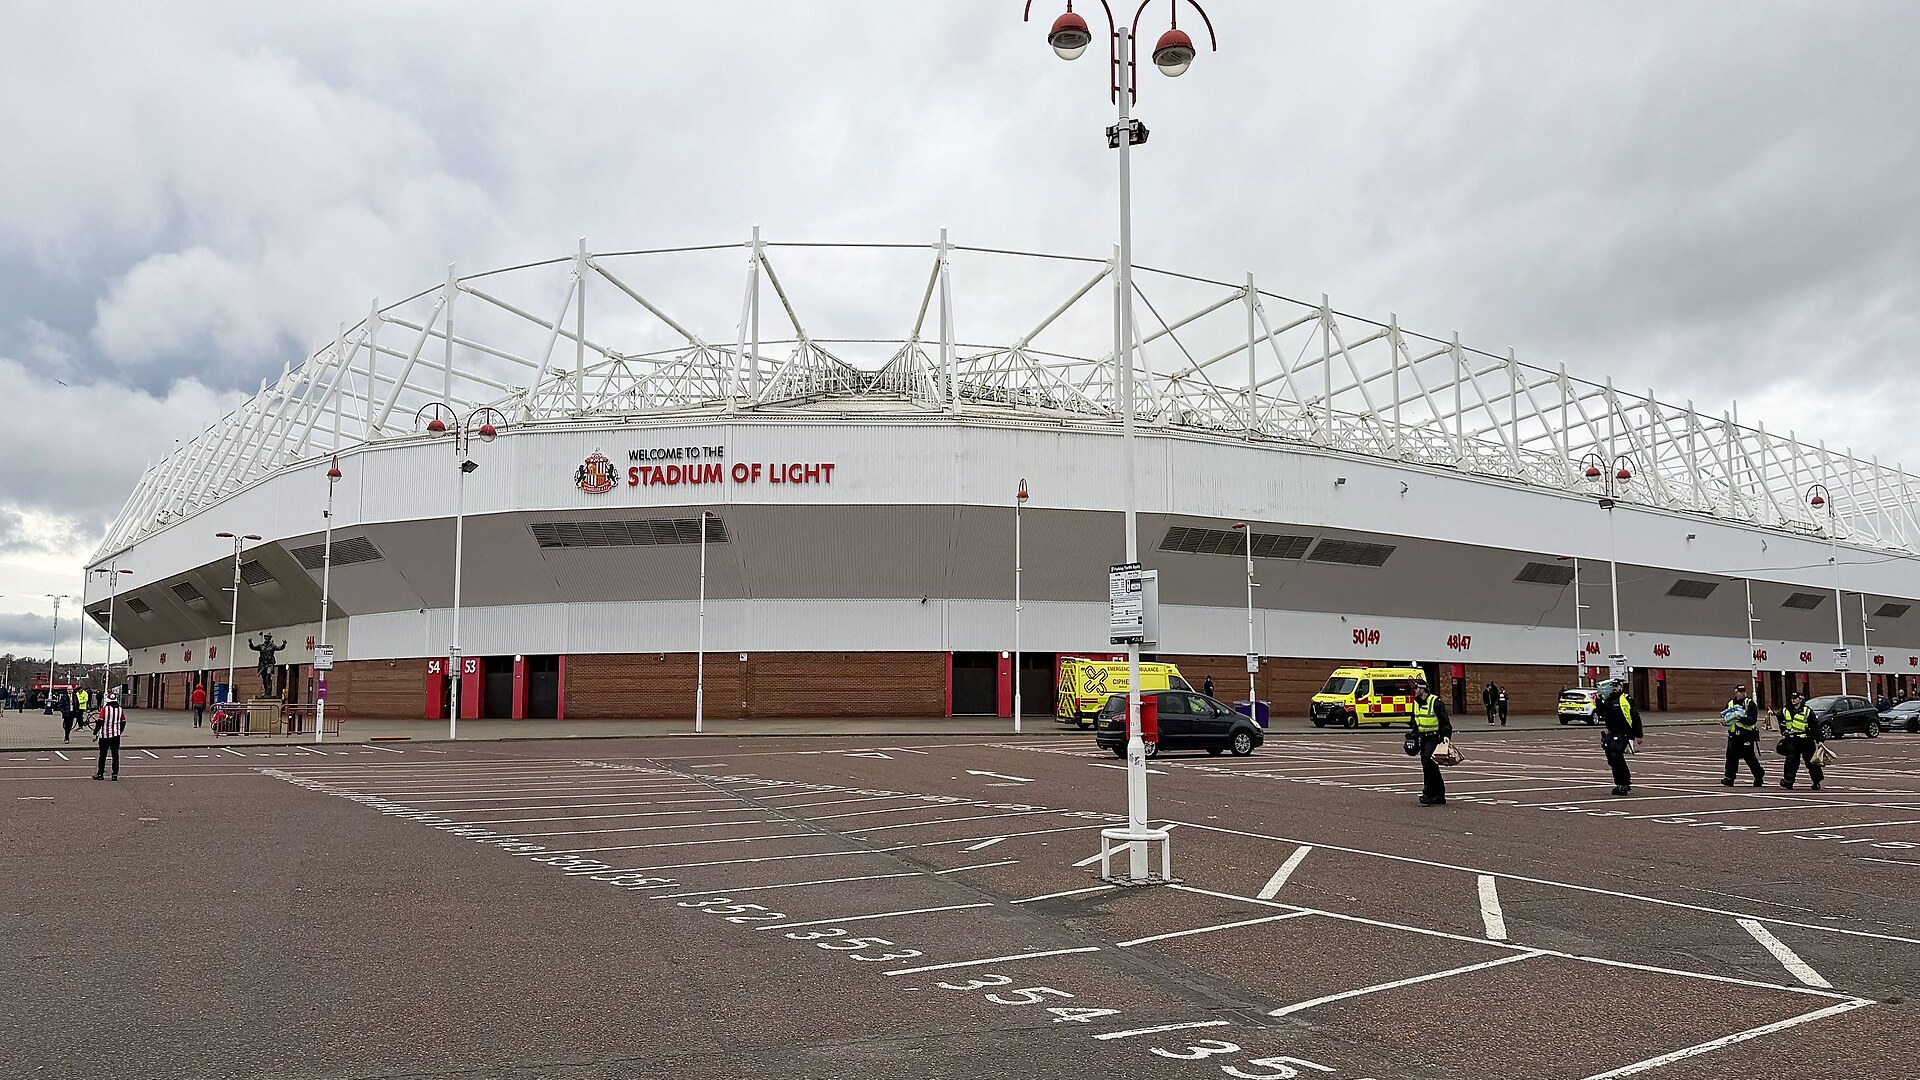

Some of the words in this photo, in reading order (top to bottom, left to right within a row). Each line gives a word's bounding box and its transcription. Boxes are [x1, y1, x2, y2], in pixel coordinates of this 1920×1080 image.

[628, 447, 683, 460] WELCOME
[684, 446, 700, 459] TO
[702, 446, 724, 458] THE
[628, 463, 723, 487] STADIUM
[731, 463, 761, 484] OF
[769, 463, 835, 484] LIGHT
[427, 660, 440, 674] 54
[464, 659, 476, 673] 53
[531, 855, 611, 871] 350
[589, 873, 680, 891] 351
[677, 898, 787, 924] 352
[784, 928, 923, 962] 353
[935, 973, 1122, 1023] 354
[1149, 1039, 1378, 1080] 35
